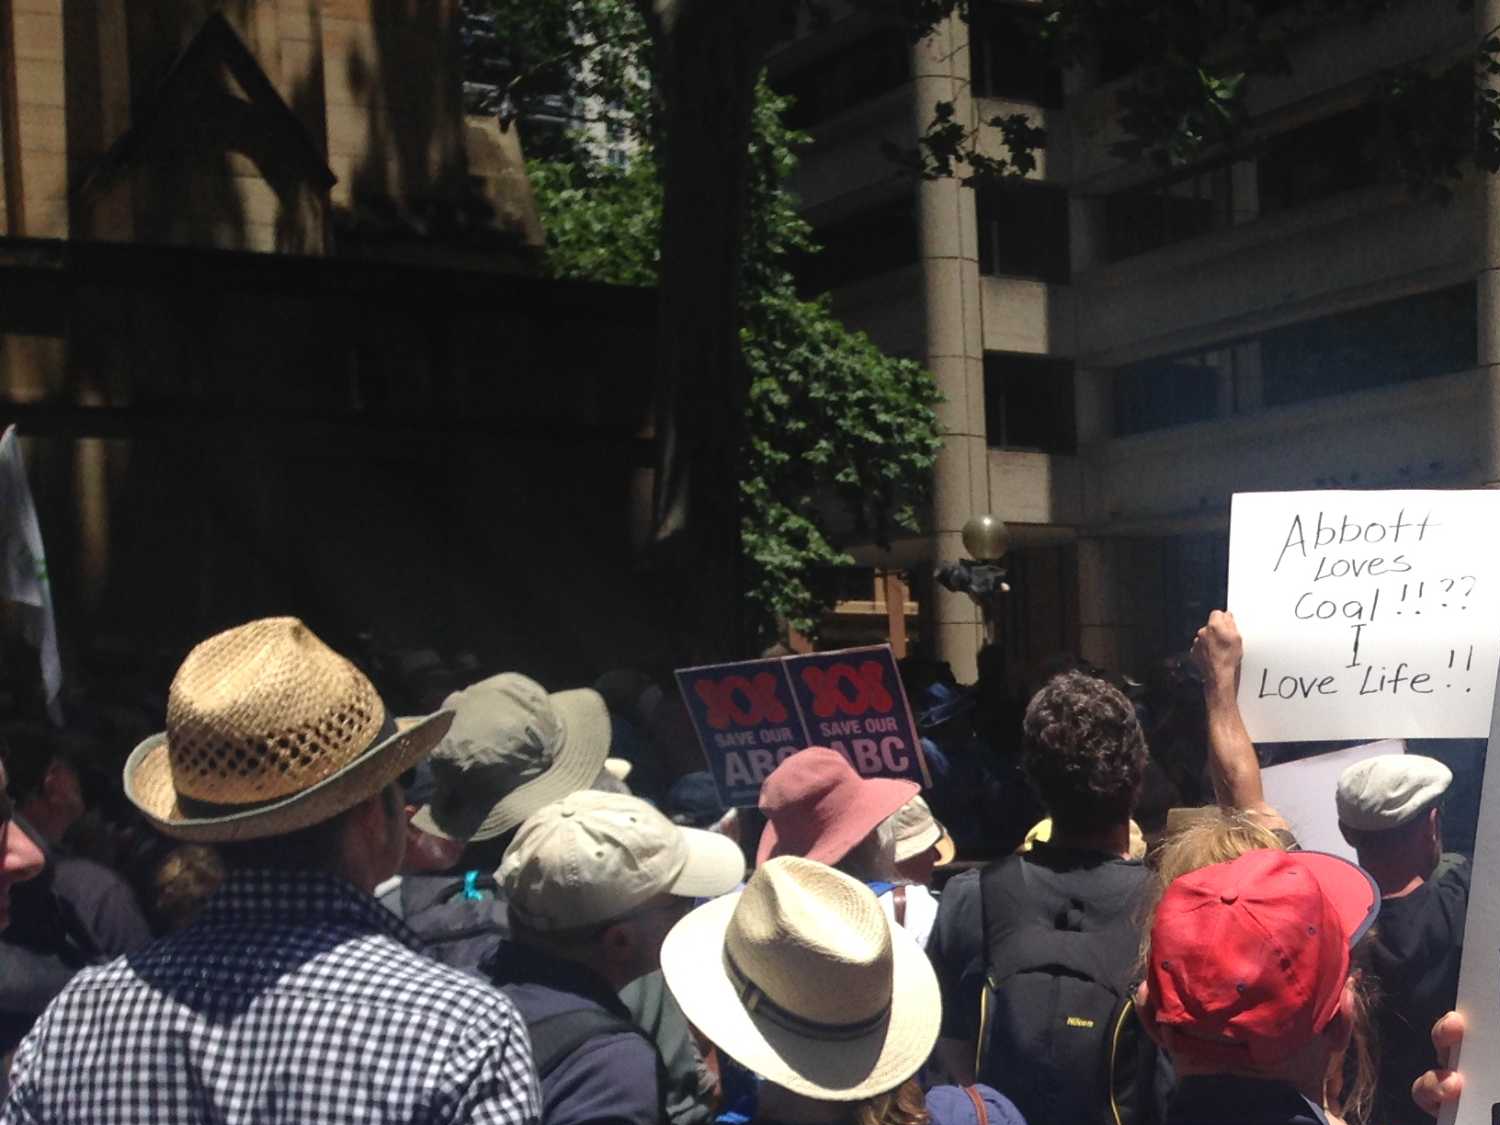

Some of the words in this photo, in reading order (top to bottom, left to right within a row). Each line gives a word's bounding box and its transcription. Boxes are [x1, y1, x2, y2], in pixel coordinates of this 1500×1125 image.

[1275, 508, 1441, 572] Abbott
[1345, 624, 1367, 668] I
[1258, 668, 1337, 700] Love
[715, 730, 757, 748] SAVE
[759, 727, 794, 745] OUR
[819, 719, 862, 738] SAVE
[864, 716, 898, 733] OUR
